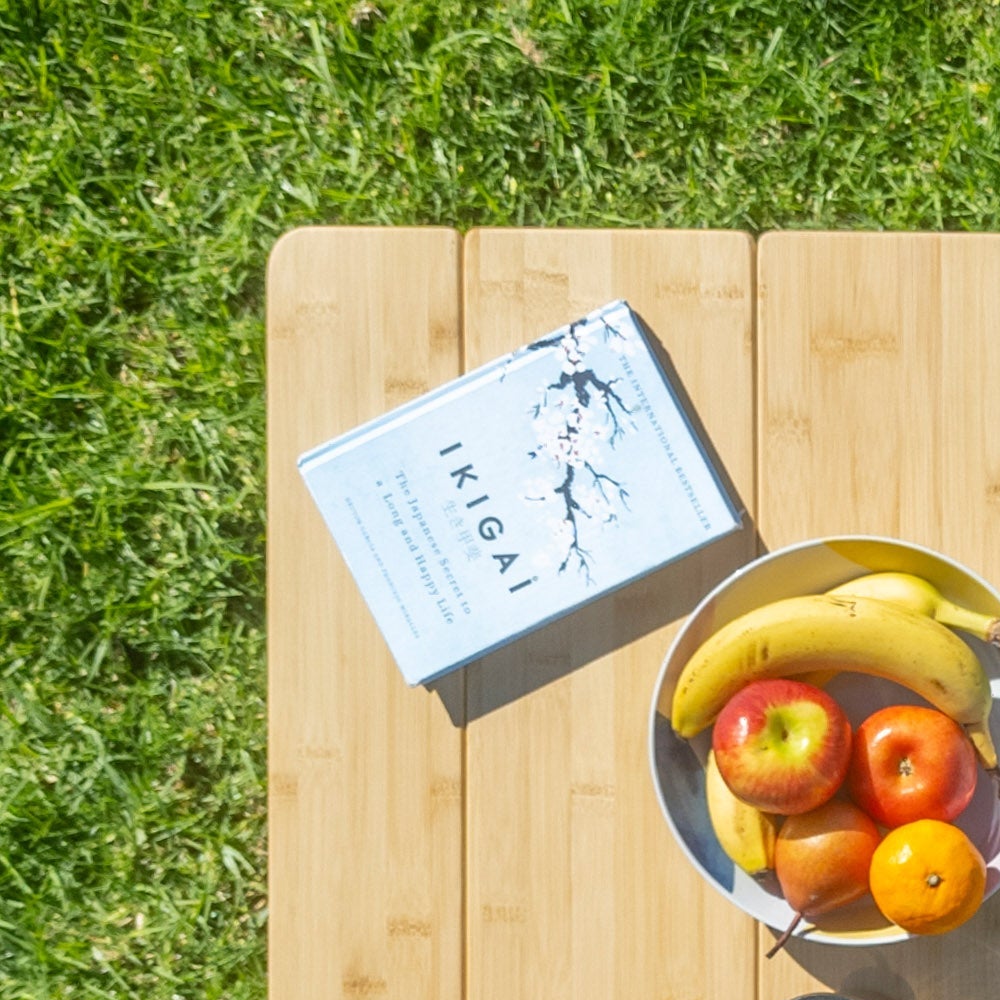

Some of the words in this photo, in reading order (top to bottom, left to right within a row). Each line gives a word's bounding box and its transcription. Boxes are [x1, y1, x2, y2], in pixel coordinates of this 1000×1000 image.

[438, 440, 533, 594] IKIGAI
[617, 354, 634, 377] THE
[628, 378, 679, 464] INTERNATIONAL
[673, 465, 712, 531] BESTSELLER
[380, 492, 406, 527] Long
[400, 527, 419, 552] and
[411, 554, 442, 598] Happy
[436, 597, 456, 625] Life
[393, 470, 413, 496] The
[405, 497, 444, 557] Japanese
[438, 557, 465, 598] Secret
[459, 600, 473, 615] to
